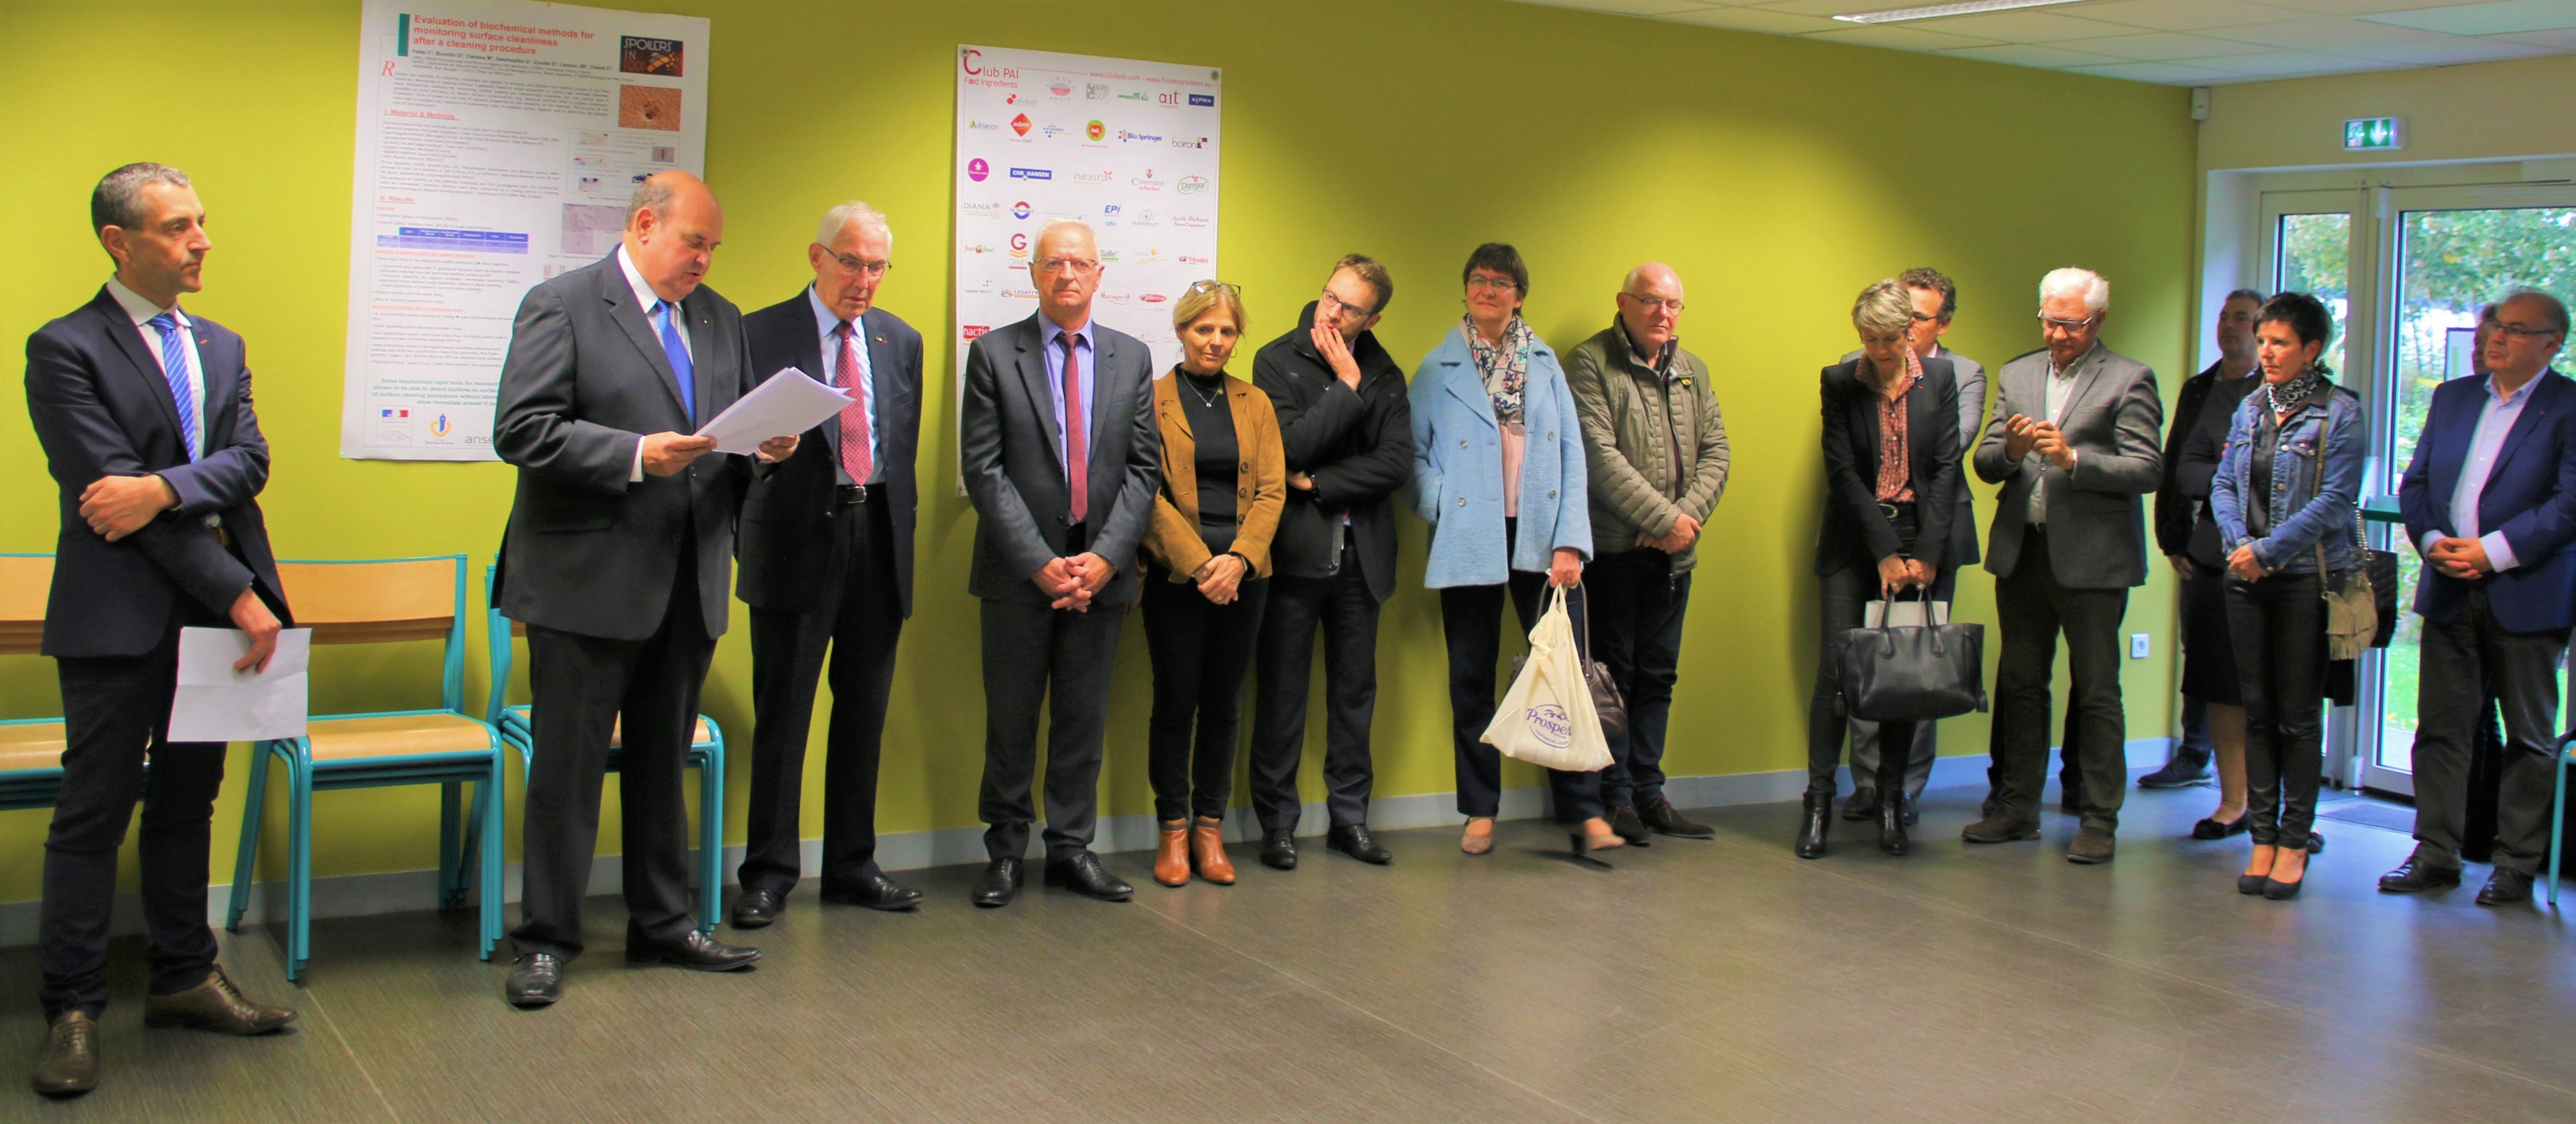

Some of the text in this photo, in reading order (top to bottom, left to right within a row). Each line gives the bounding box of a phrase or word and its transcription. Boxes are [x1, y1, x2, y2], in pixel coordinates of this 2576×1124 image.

[415, 15, 465, 27] Evaluation
[480, 21, 535, 34] biochemical
[538, 29, 578, 38] methods
[414, 27, 558, 46] monitoring surface cleanliness
[413, 37, 435, 45] after
[447, 40, 486, 51] cleaning
[489, 44, 536, 55] procedure
[624, 38, 672, 52] SPOILERS
[963, 50, 999, 77] Club
[981, 78, 1018, 88] Ingredients
[1138, 134, 1163, 143] Springer
[963, 202, 991, 210] DIANA
[963, 326, 990, 337] nactis
[465, 435, 494, 444] anse
